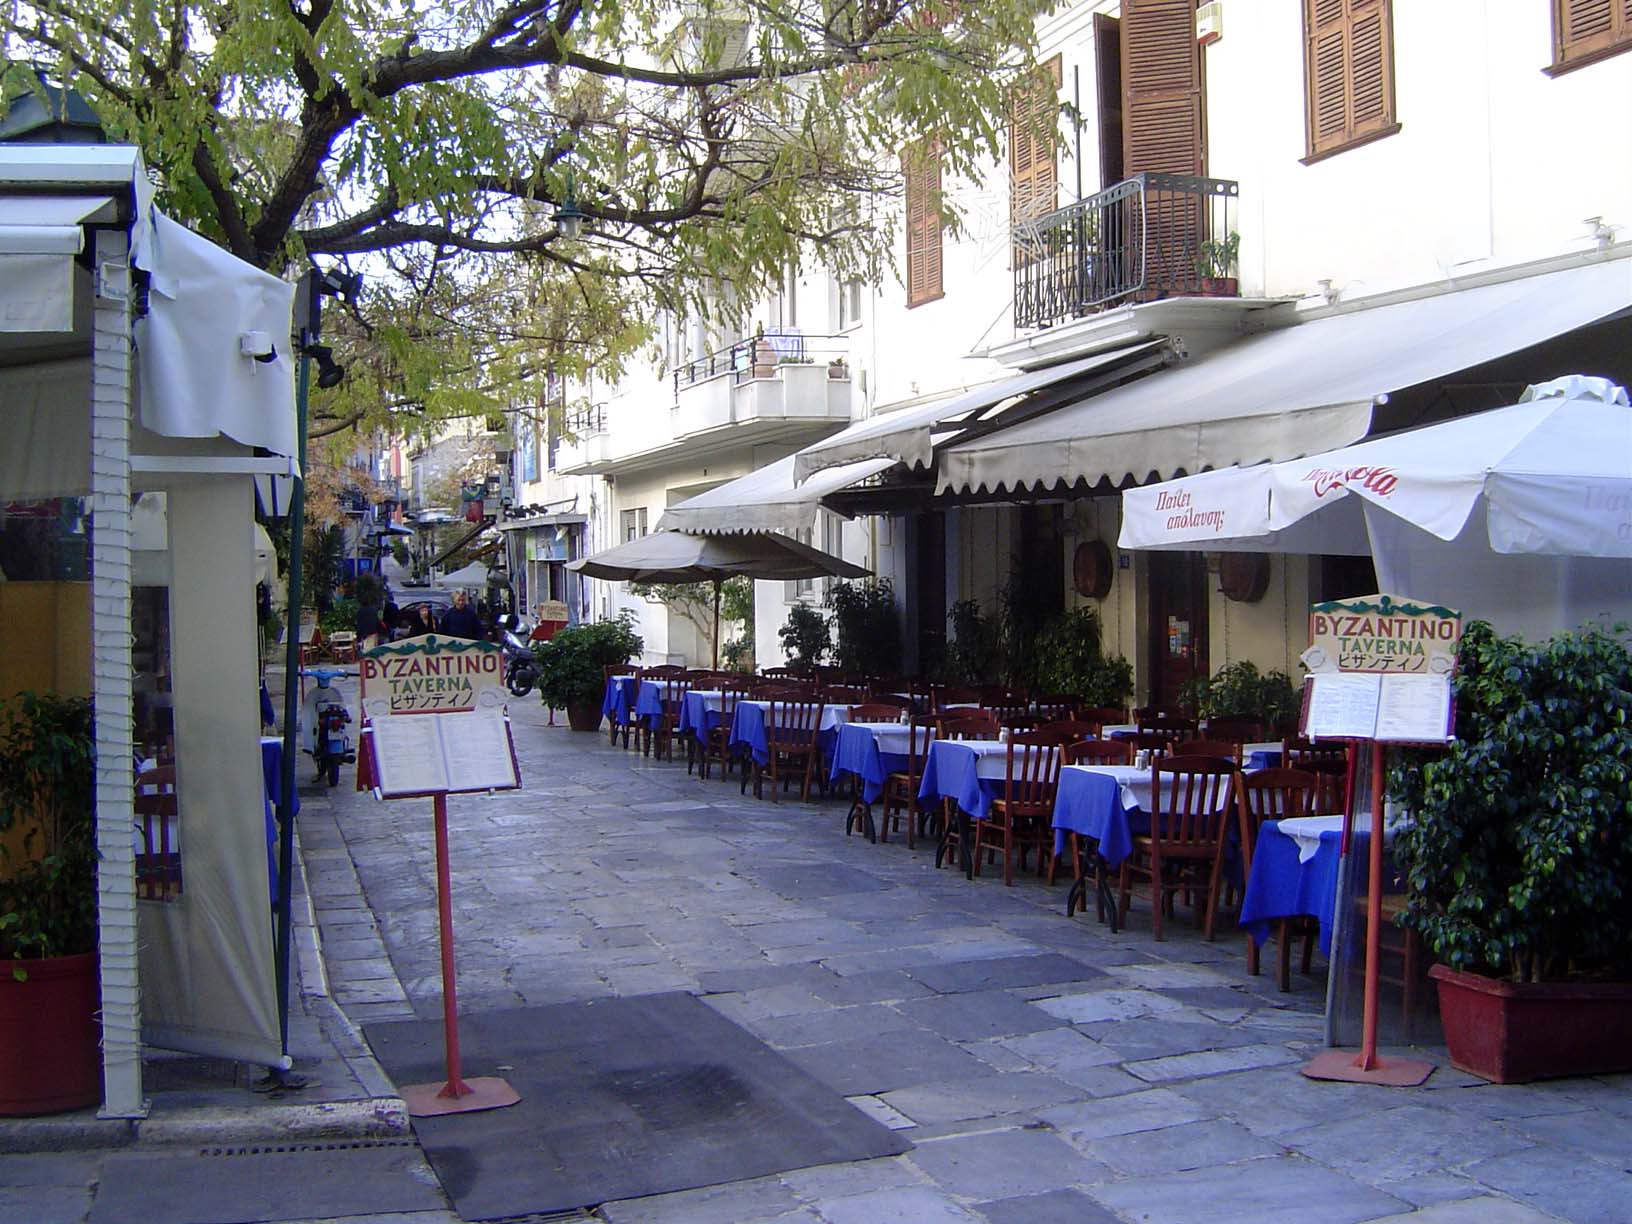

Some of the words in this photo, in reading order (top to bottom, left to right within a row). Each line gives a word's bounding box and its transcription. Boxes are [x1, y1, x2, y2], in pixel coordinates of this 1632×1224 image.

[1315, 615, 1454, 641] BYZANTINO
[1337, 637, 1425, 656] TAVERNA
[365, 654, 497, 679] BYZANTINO
[389, 676, 473, 694] TAVERNA
